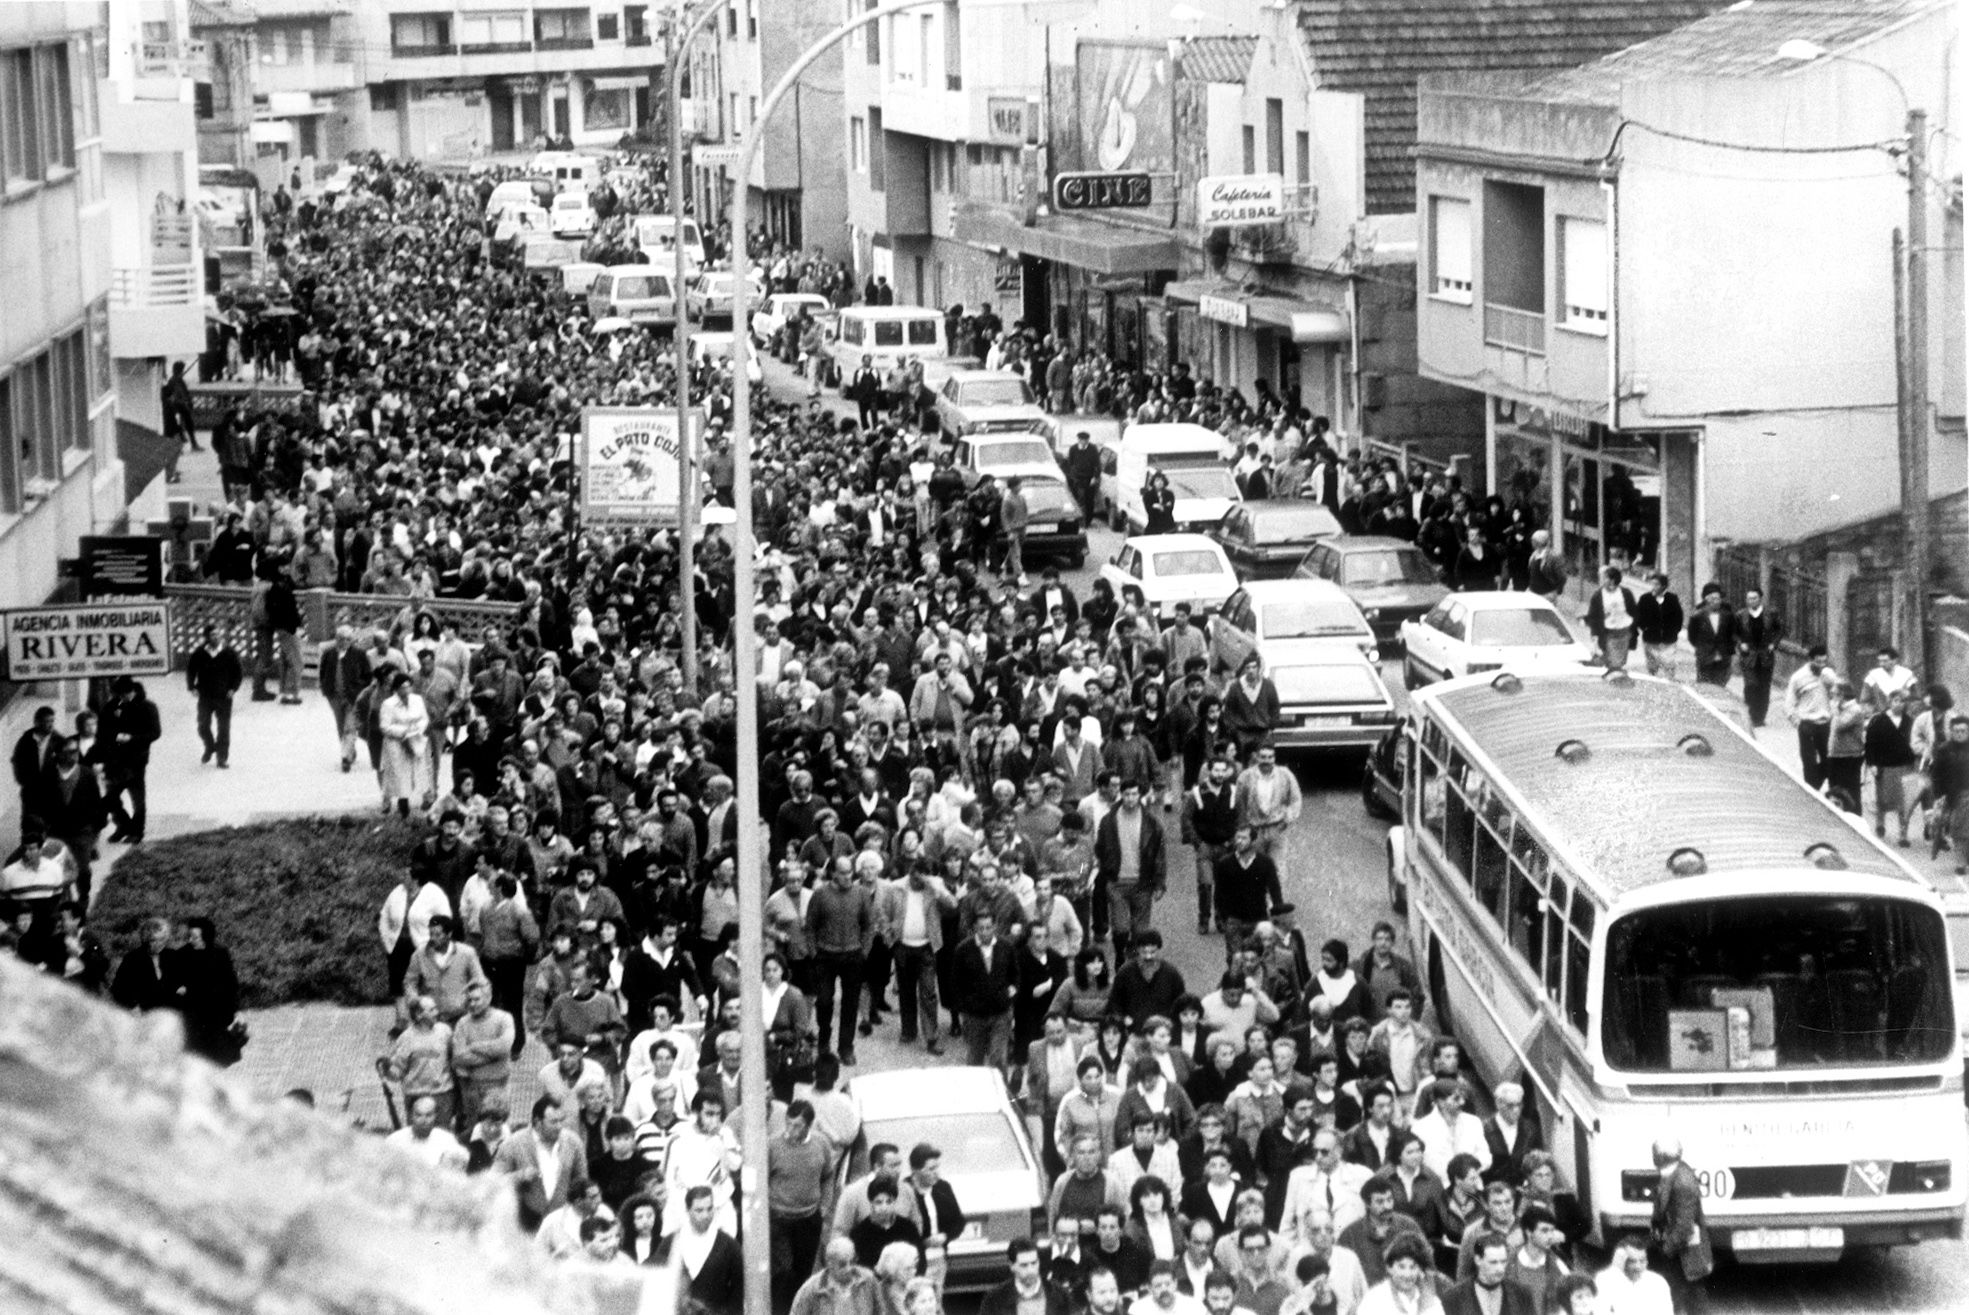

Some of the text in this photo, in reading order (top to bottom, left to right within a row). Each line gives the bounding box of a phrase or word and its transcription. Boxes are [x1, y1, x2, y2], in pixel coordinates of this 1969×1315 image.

[1063, 178, 1148, 205] CINE
[1209, 206, 1278, 221] SOLEBAR
[600, 446, 616, 460] EL
[615, 433, 649, 449] PATO
[13, 611, 162, 631] AGENCIA INMOBILIARIA
[21, 631, 158, 660] RIVERA
[1699, 1170, 1727, 1198] 90
